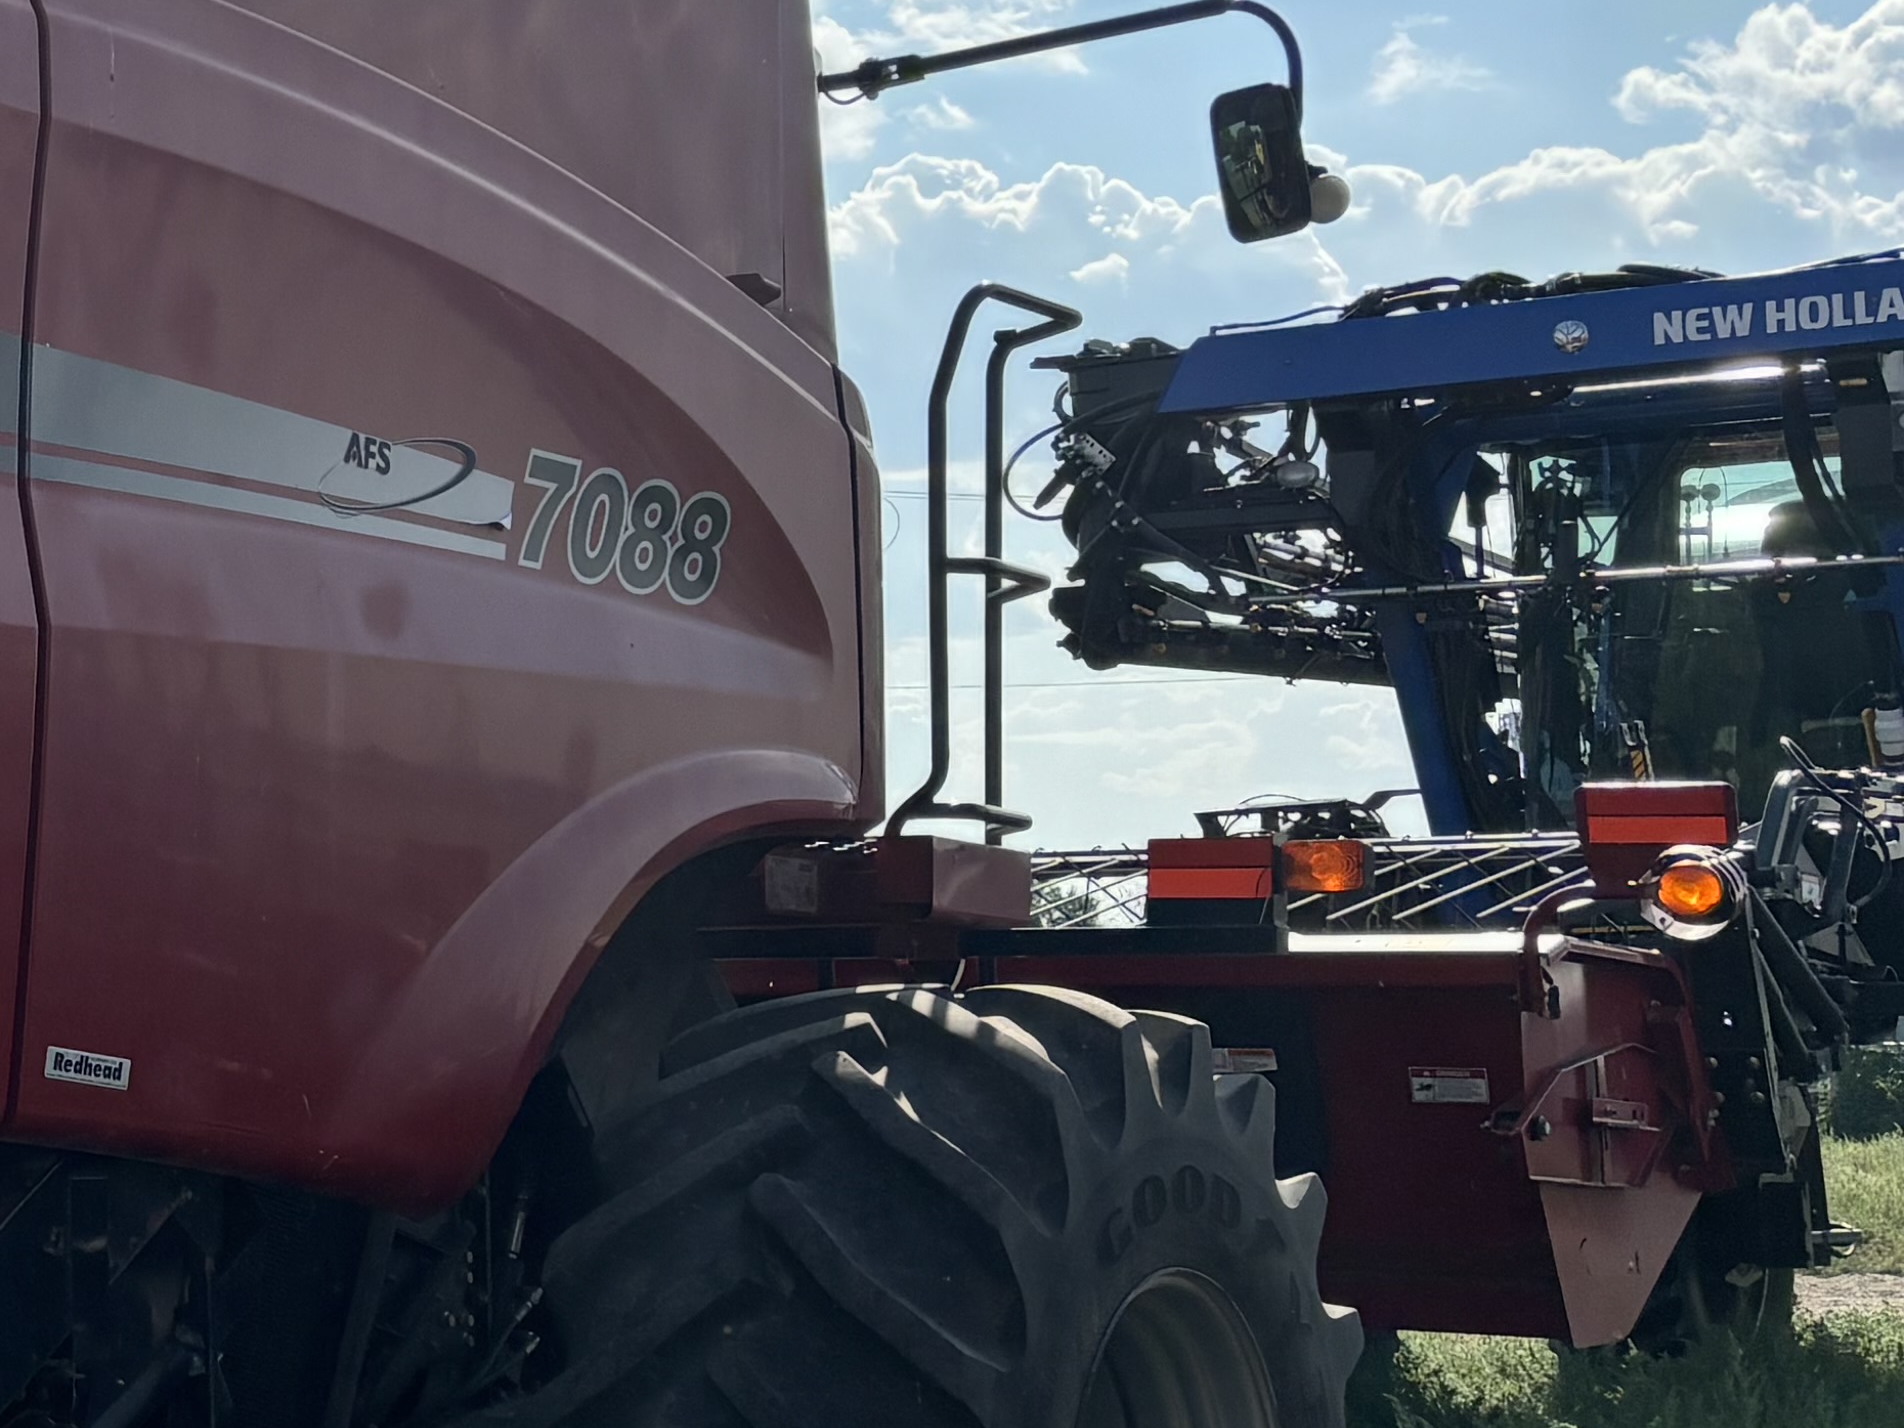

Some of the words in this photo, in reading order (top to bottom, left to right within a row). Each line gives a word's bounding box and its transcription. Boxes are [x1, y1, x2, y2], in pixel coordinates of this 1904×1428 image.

[1653, 302, 1754, 346] NEW
[343, 431, 392, 475] AFS
[517, 448, 732, 605] 7088
[53, 1051, 124, 1081] Redhead
